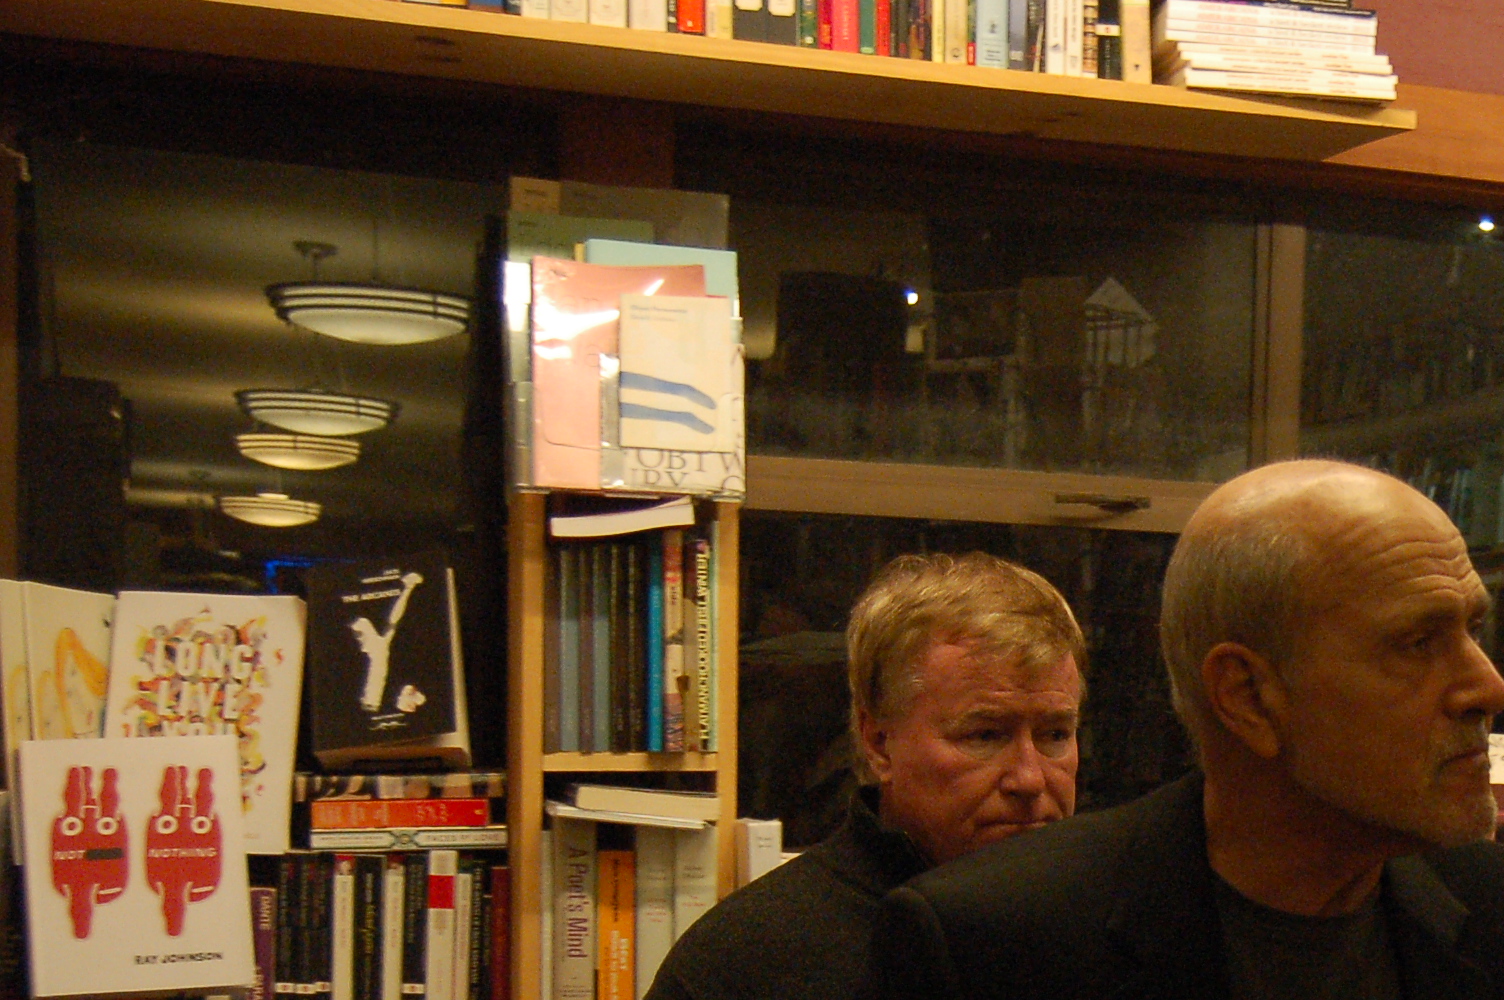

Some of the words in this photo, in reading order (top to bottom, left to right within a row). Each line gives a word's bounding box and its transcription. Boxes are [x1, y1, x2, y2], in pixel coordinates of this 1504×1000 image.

[153, 640, 254, 679] LONG
[158, 680, 242, 719] LIVE
[148, 848, 218, 858] NOTHING
[567, 848, 587, 857] A
[566, 864, 588, 912] Poet's
[259, 895, 270, 930] DANTE
[567, 918, 588, 958] Mind
[135, 955, 157, 965] RAY
[161, 952, 223, 964] JOHNSON
